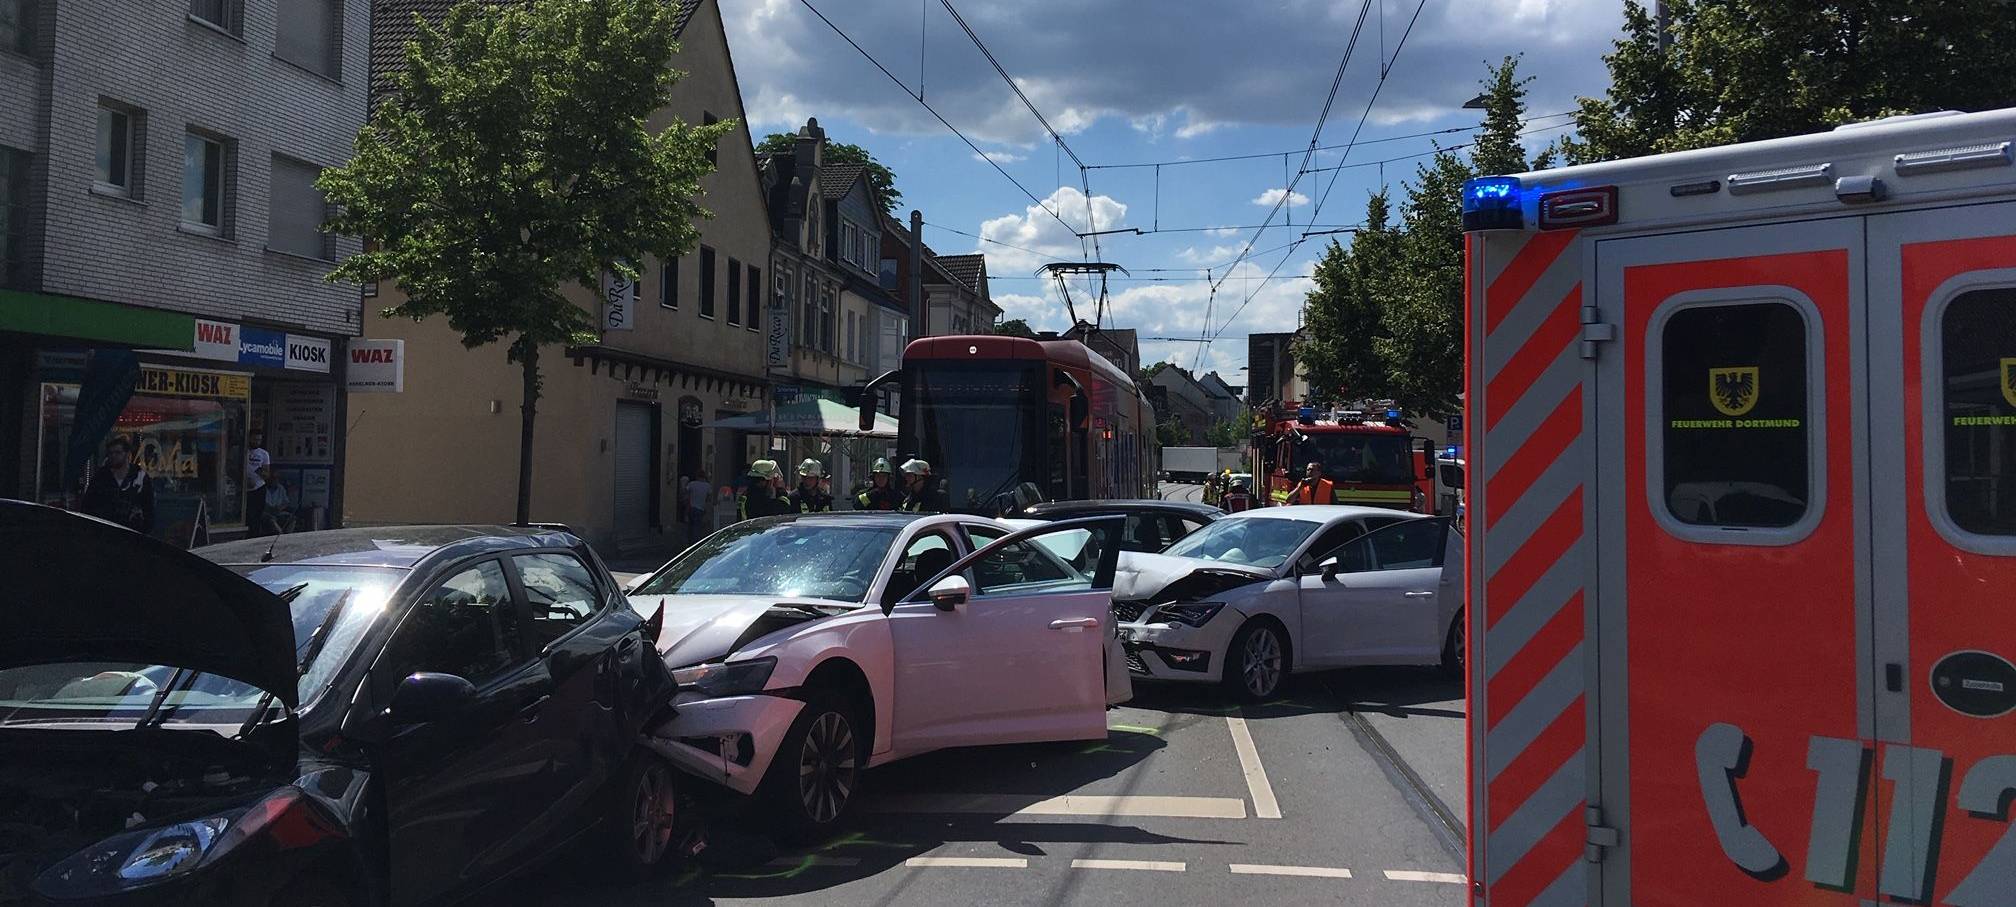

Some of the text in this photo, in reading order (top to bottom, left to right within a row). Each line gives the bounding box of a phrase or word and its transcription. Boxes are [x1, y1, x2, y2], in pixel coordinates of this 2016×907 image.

[197, 323, 232, 345] WAZ
[289, 344, 326, 363] KIOSK
[351, 349, 394, 364] WAZ
[137, 370, 220, 395] NER-KIOSK
[1450, 416, 1460, 430] P
[1671, 418, 1800, 429] FEUERWEHR DORTMUND
[1953, 416, 2016, 426] FEUERWEH
[1804, 735, 2016, 906] 112
